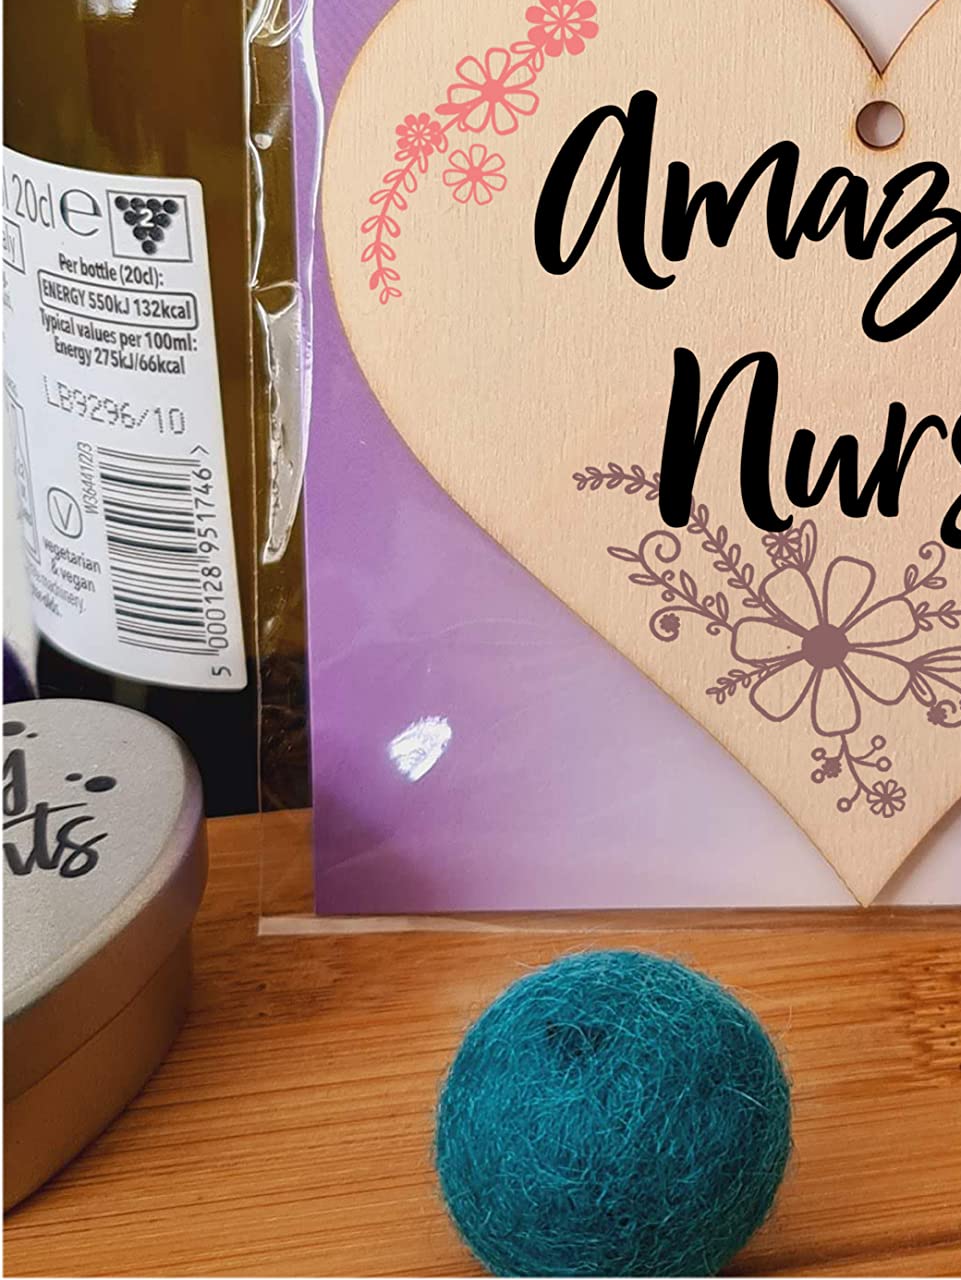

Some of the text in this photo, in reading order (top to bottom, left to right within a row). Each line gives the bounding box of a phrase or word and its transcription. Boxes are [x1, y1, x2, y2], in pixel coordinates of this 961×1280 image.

[12, 174, 55, 229] 20cl
[58, 252, 164, 289] Per bottle (20cl):
[42, 278, 86, 308] ENERGY
[88, 292, 130, 316] 550kJ
[133, 299, 192, 320] 132kcal
[39, 306, 198, 352] Typical values per 100ml:
[54, 336, 186, 375] Energy 275kJ/66kcal
[42, 536, 102, 575] vegetarian
[60, 568, 97, 593] vegan
